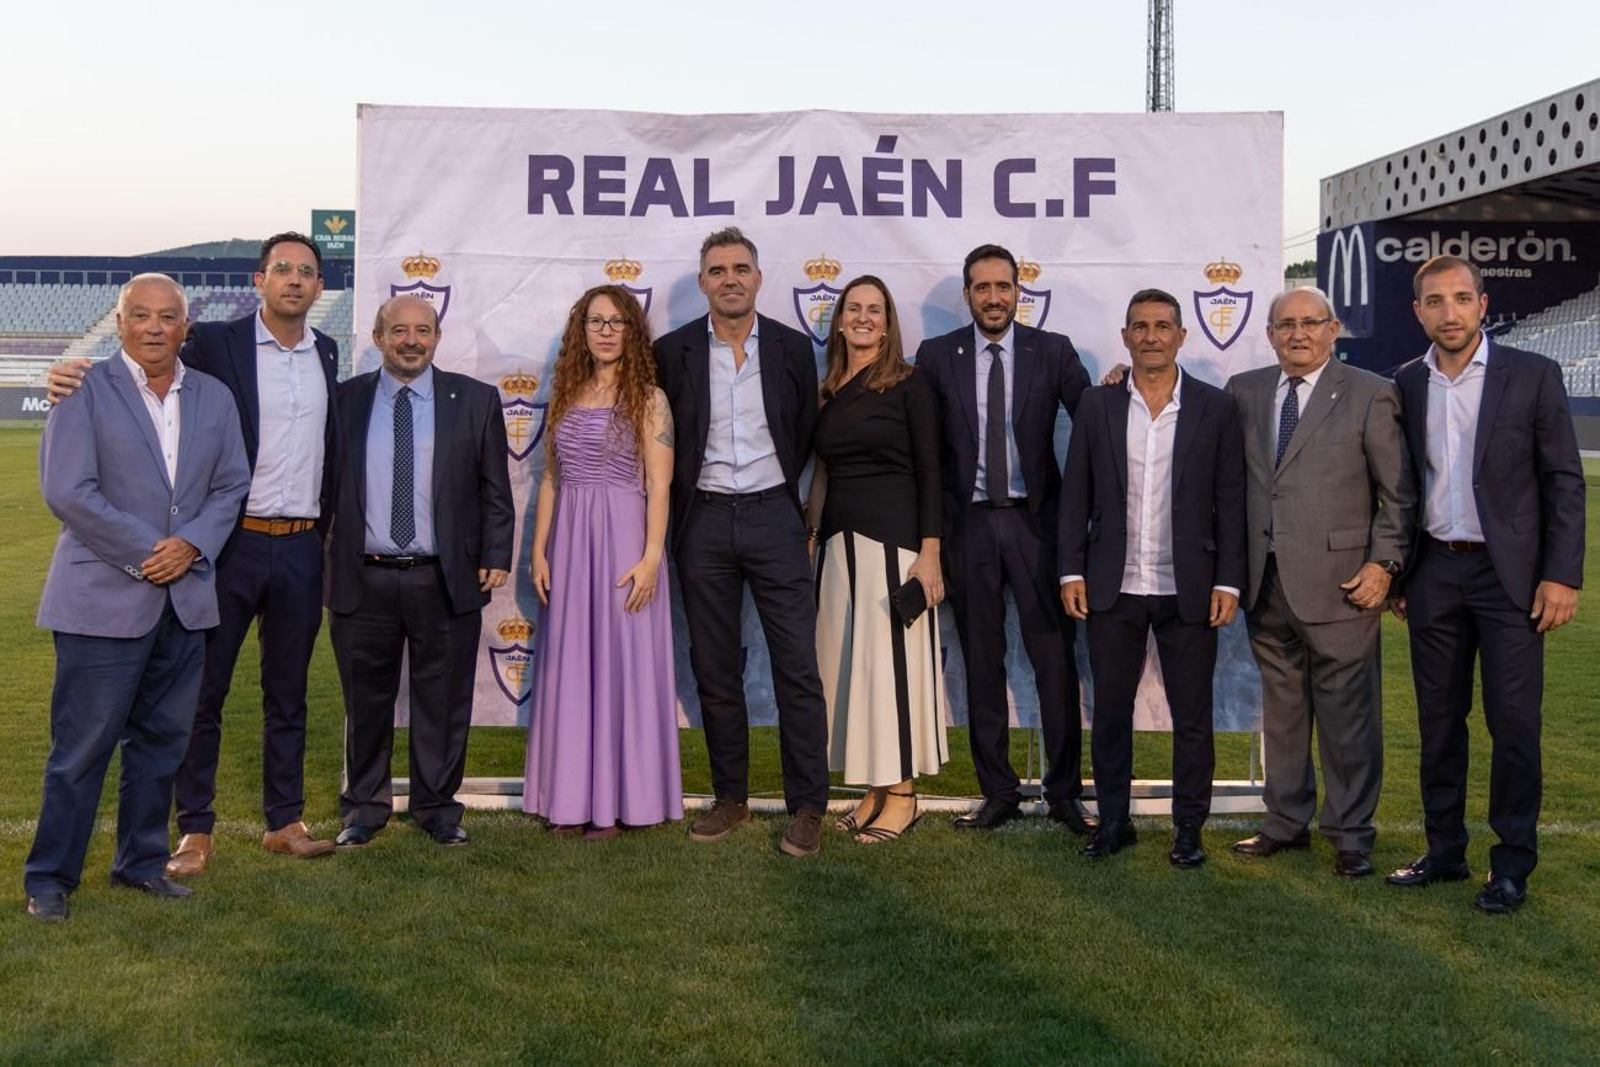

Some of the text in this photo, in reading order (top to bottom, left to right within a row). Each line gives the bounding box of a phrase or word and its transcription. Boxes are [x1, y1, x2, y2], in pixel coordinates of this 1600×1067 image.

[527, 135, 1117, 218] REAL JAÉN C.F
[1210, 297, 1237, 305] JAÉN
